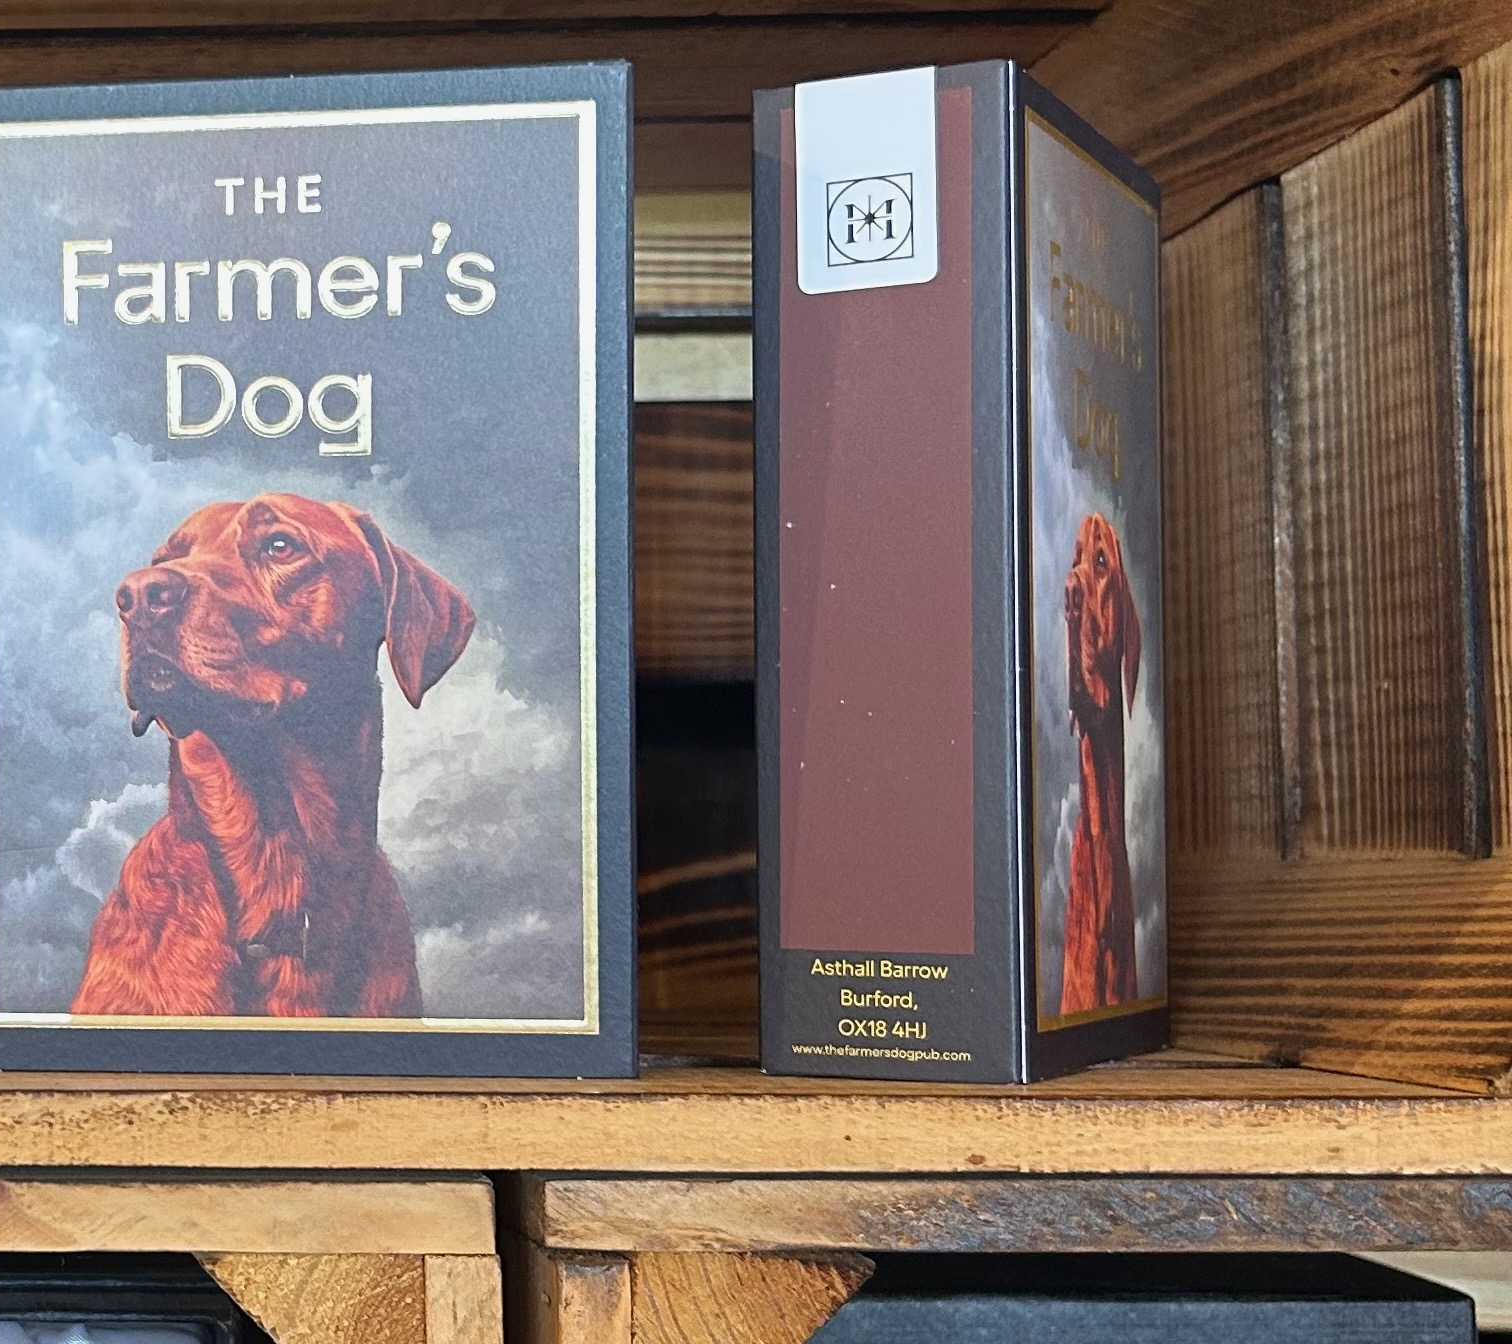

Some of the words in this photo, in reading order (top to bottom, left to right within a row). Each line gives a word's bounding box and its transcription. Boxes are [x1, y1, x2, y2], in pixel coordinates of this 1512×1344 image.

[214, 175, 322, 215] THE
[62, 222, 496, 326] Farmer's
[166, 354, 373, 456] Dog
[811, 958, 874, 978] Asthall
[880, 959, 948, 979] Barrow
[840, 989, 918, 1011] Burford,
[838, 1019, 887, 1038] OX18
[892, 1021, 927, 1040] 4HJ
[792, 1043, 971, 1062] www.thefarmersdogpub.com
